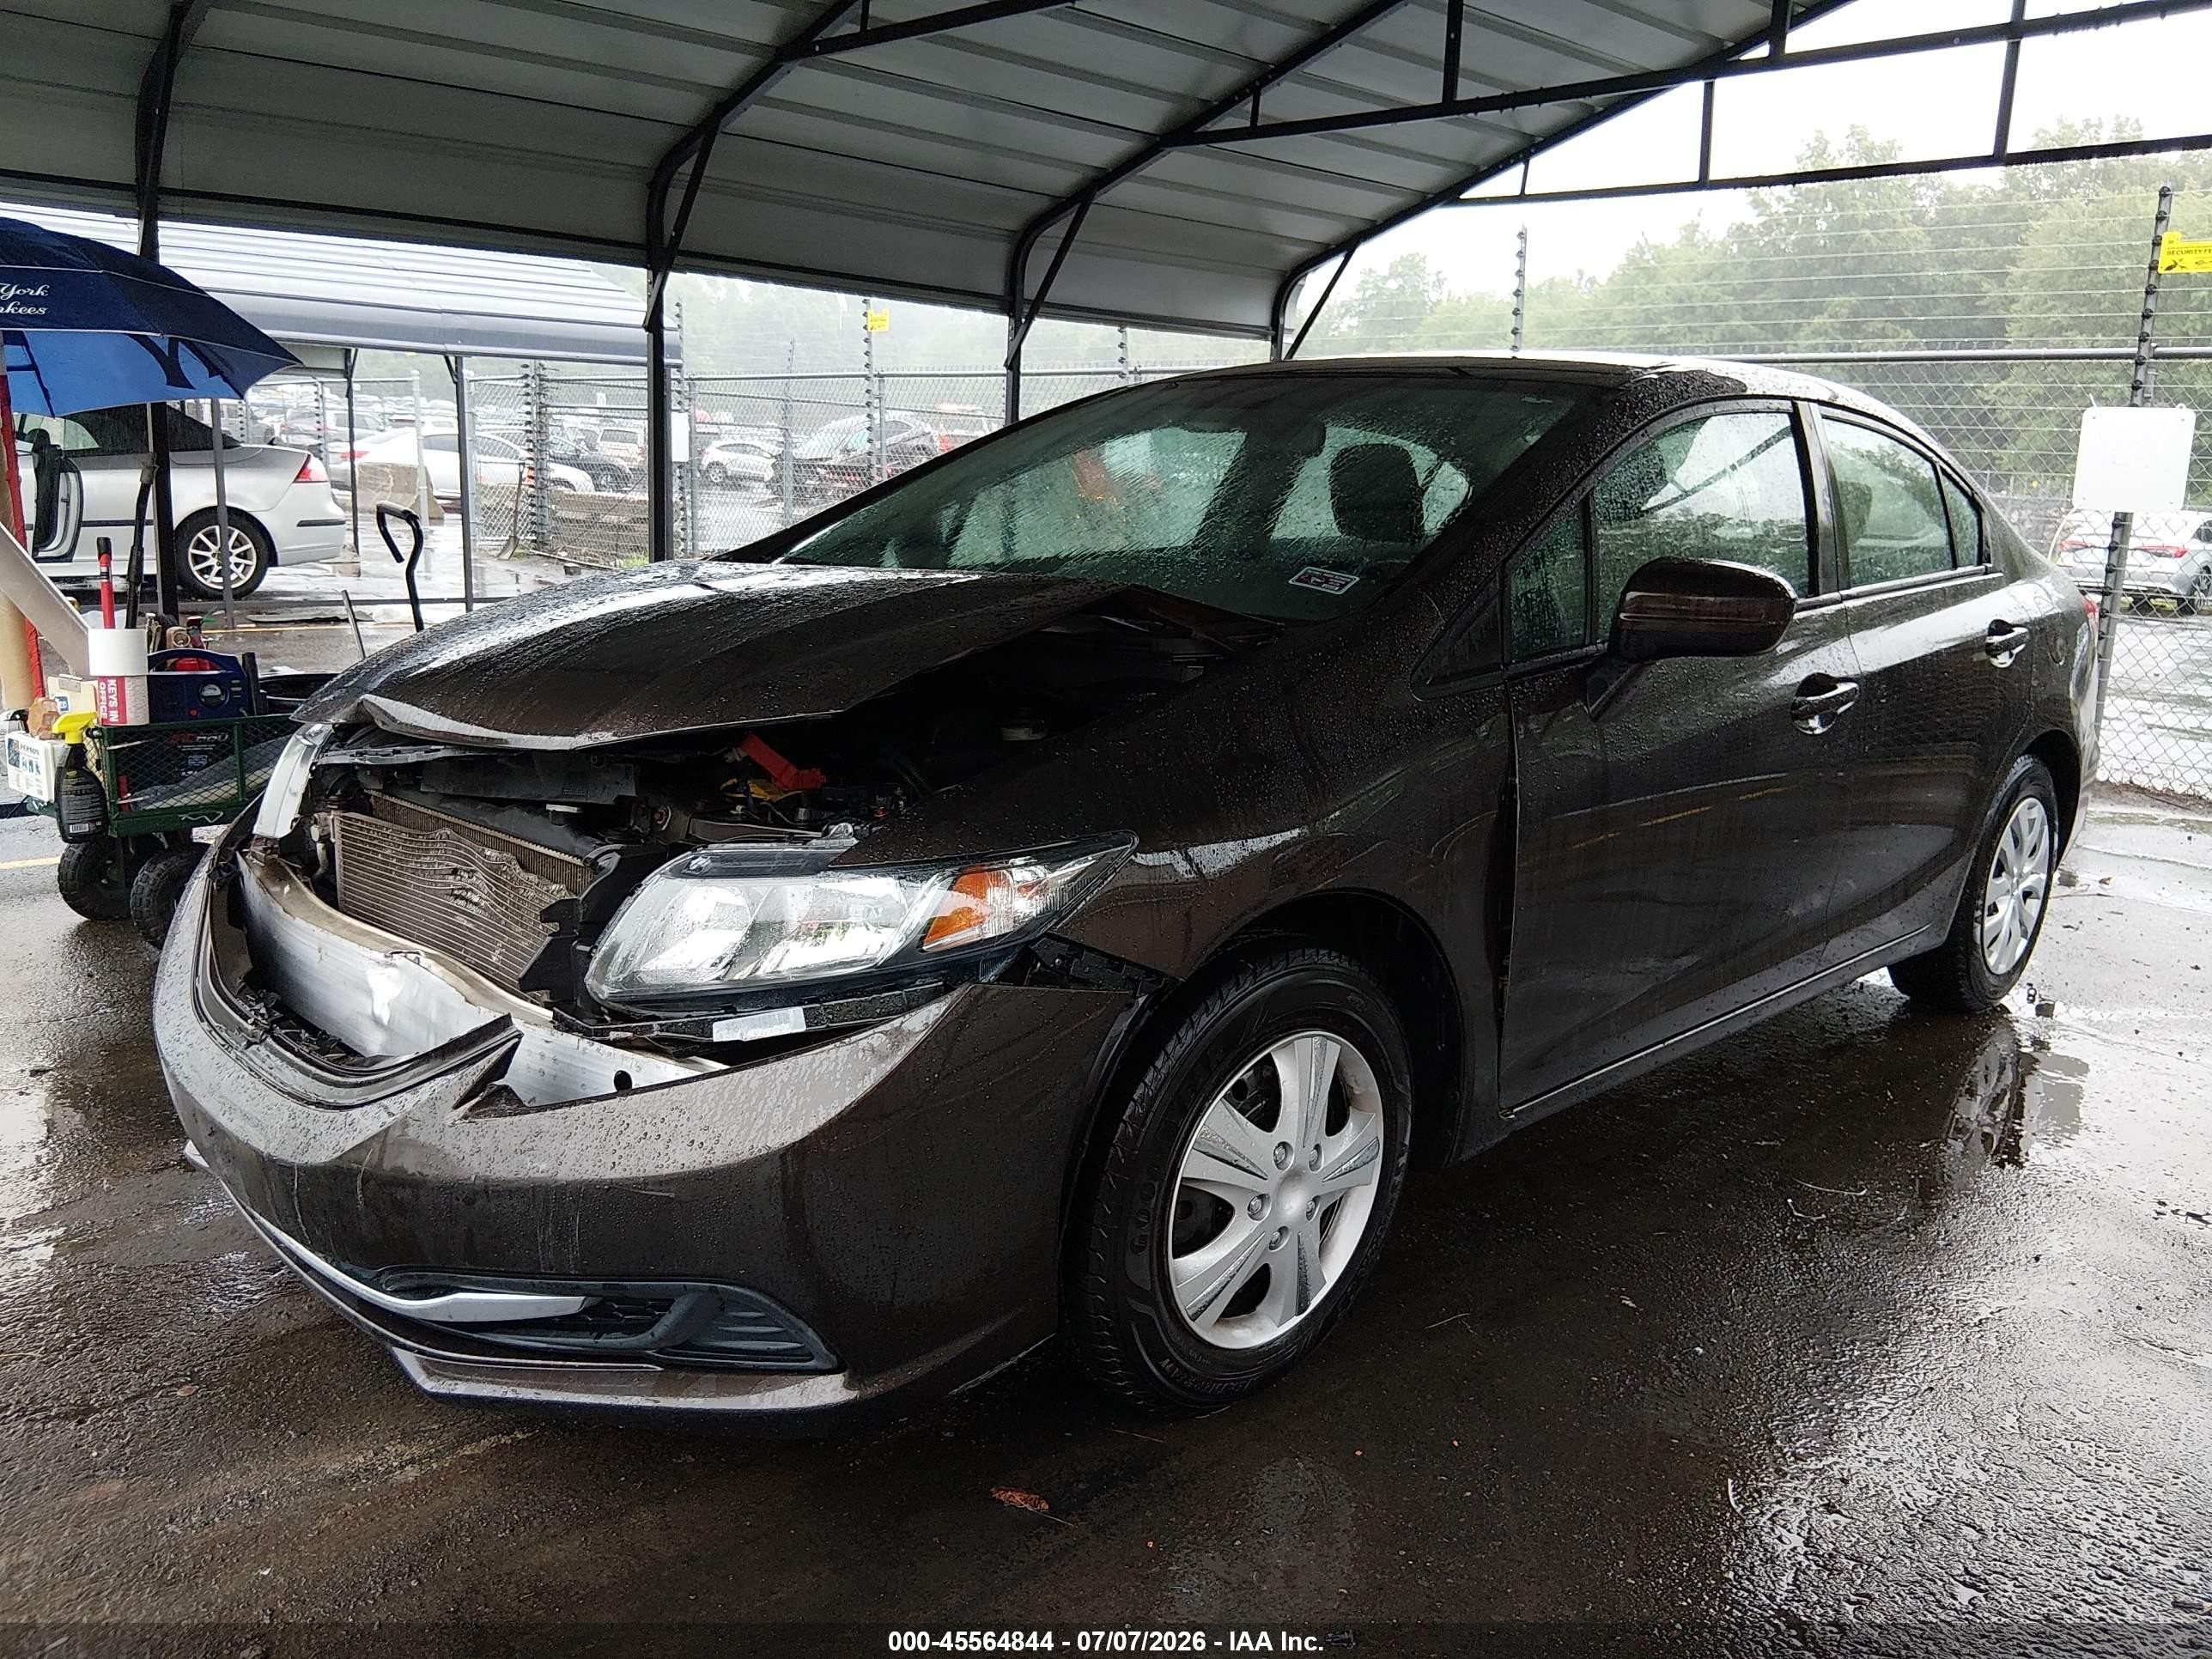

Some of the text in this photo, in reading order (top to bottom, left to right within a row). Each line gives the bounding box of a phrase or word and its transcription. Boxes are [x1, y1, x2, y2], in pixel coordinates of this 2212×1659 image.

[0, 283, 50, 301] York
[99, 682, 108, 719] OFFICE
[107, 679, 119, 722] KEYS IN
